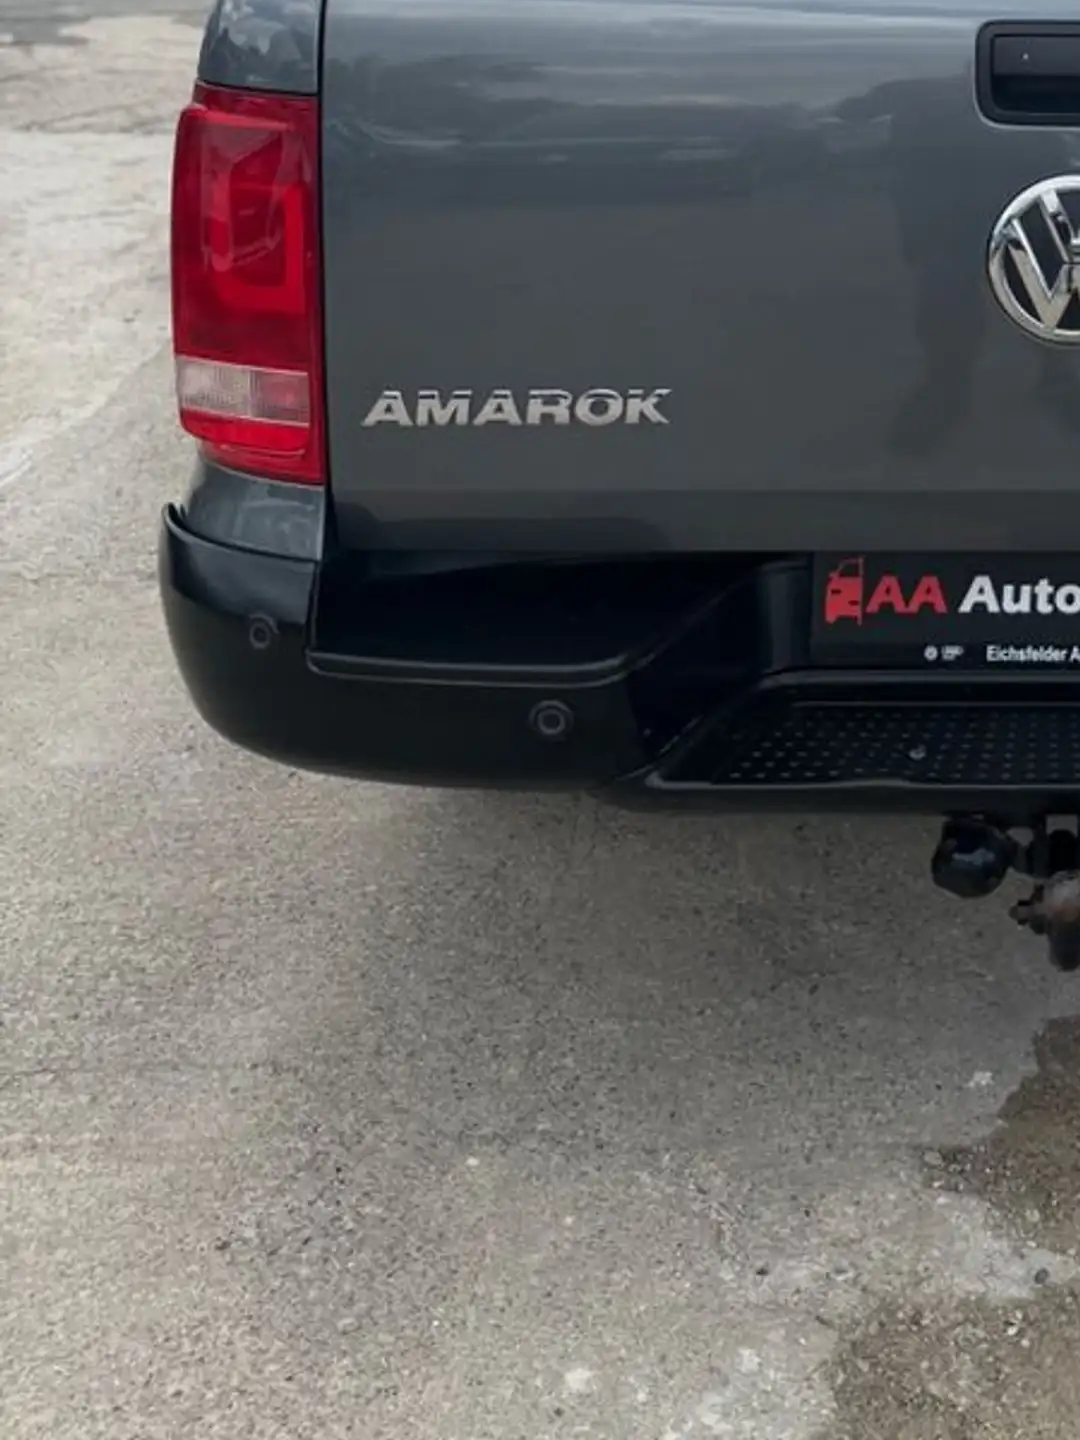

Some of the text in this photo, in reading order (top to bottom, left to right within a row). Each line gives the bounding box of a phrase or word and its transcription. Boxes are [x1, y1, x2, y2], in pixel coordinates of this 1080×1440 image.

[361, 388, 673, 427] AMAROK
[865, 575, 948, 614] AA
[986, 644, 1067, 662] Eichsfelder
